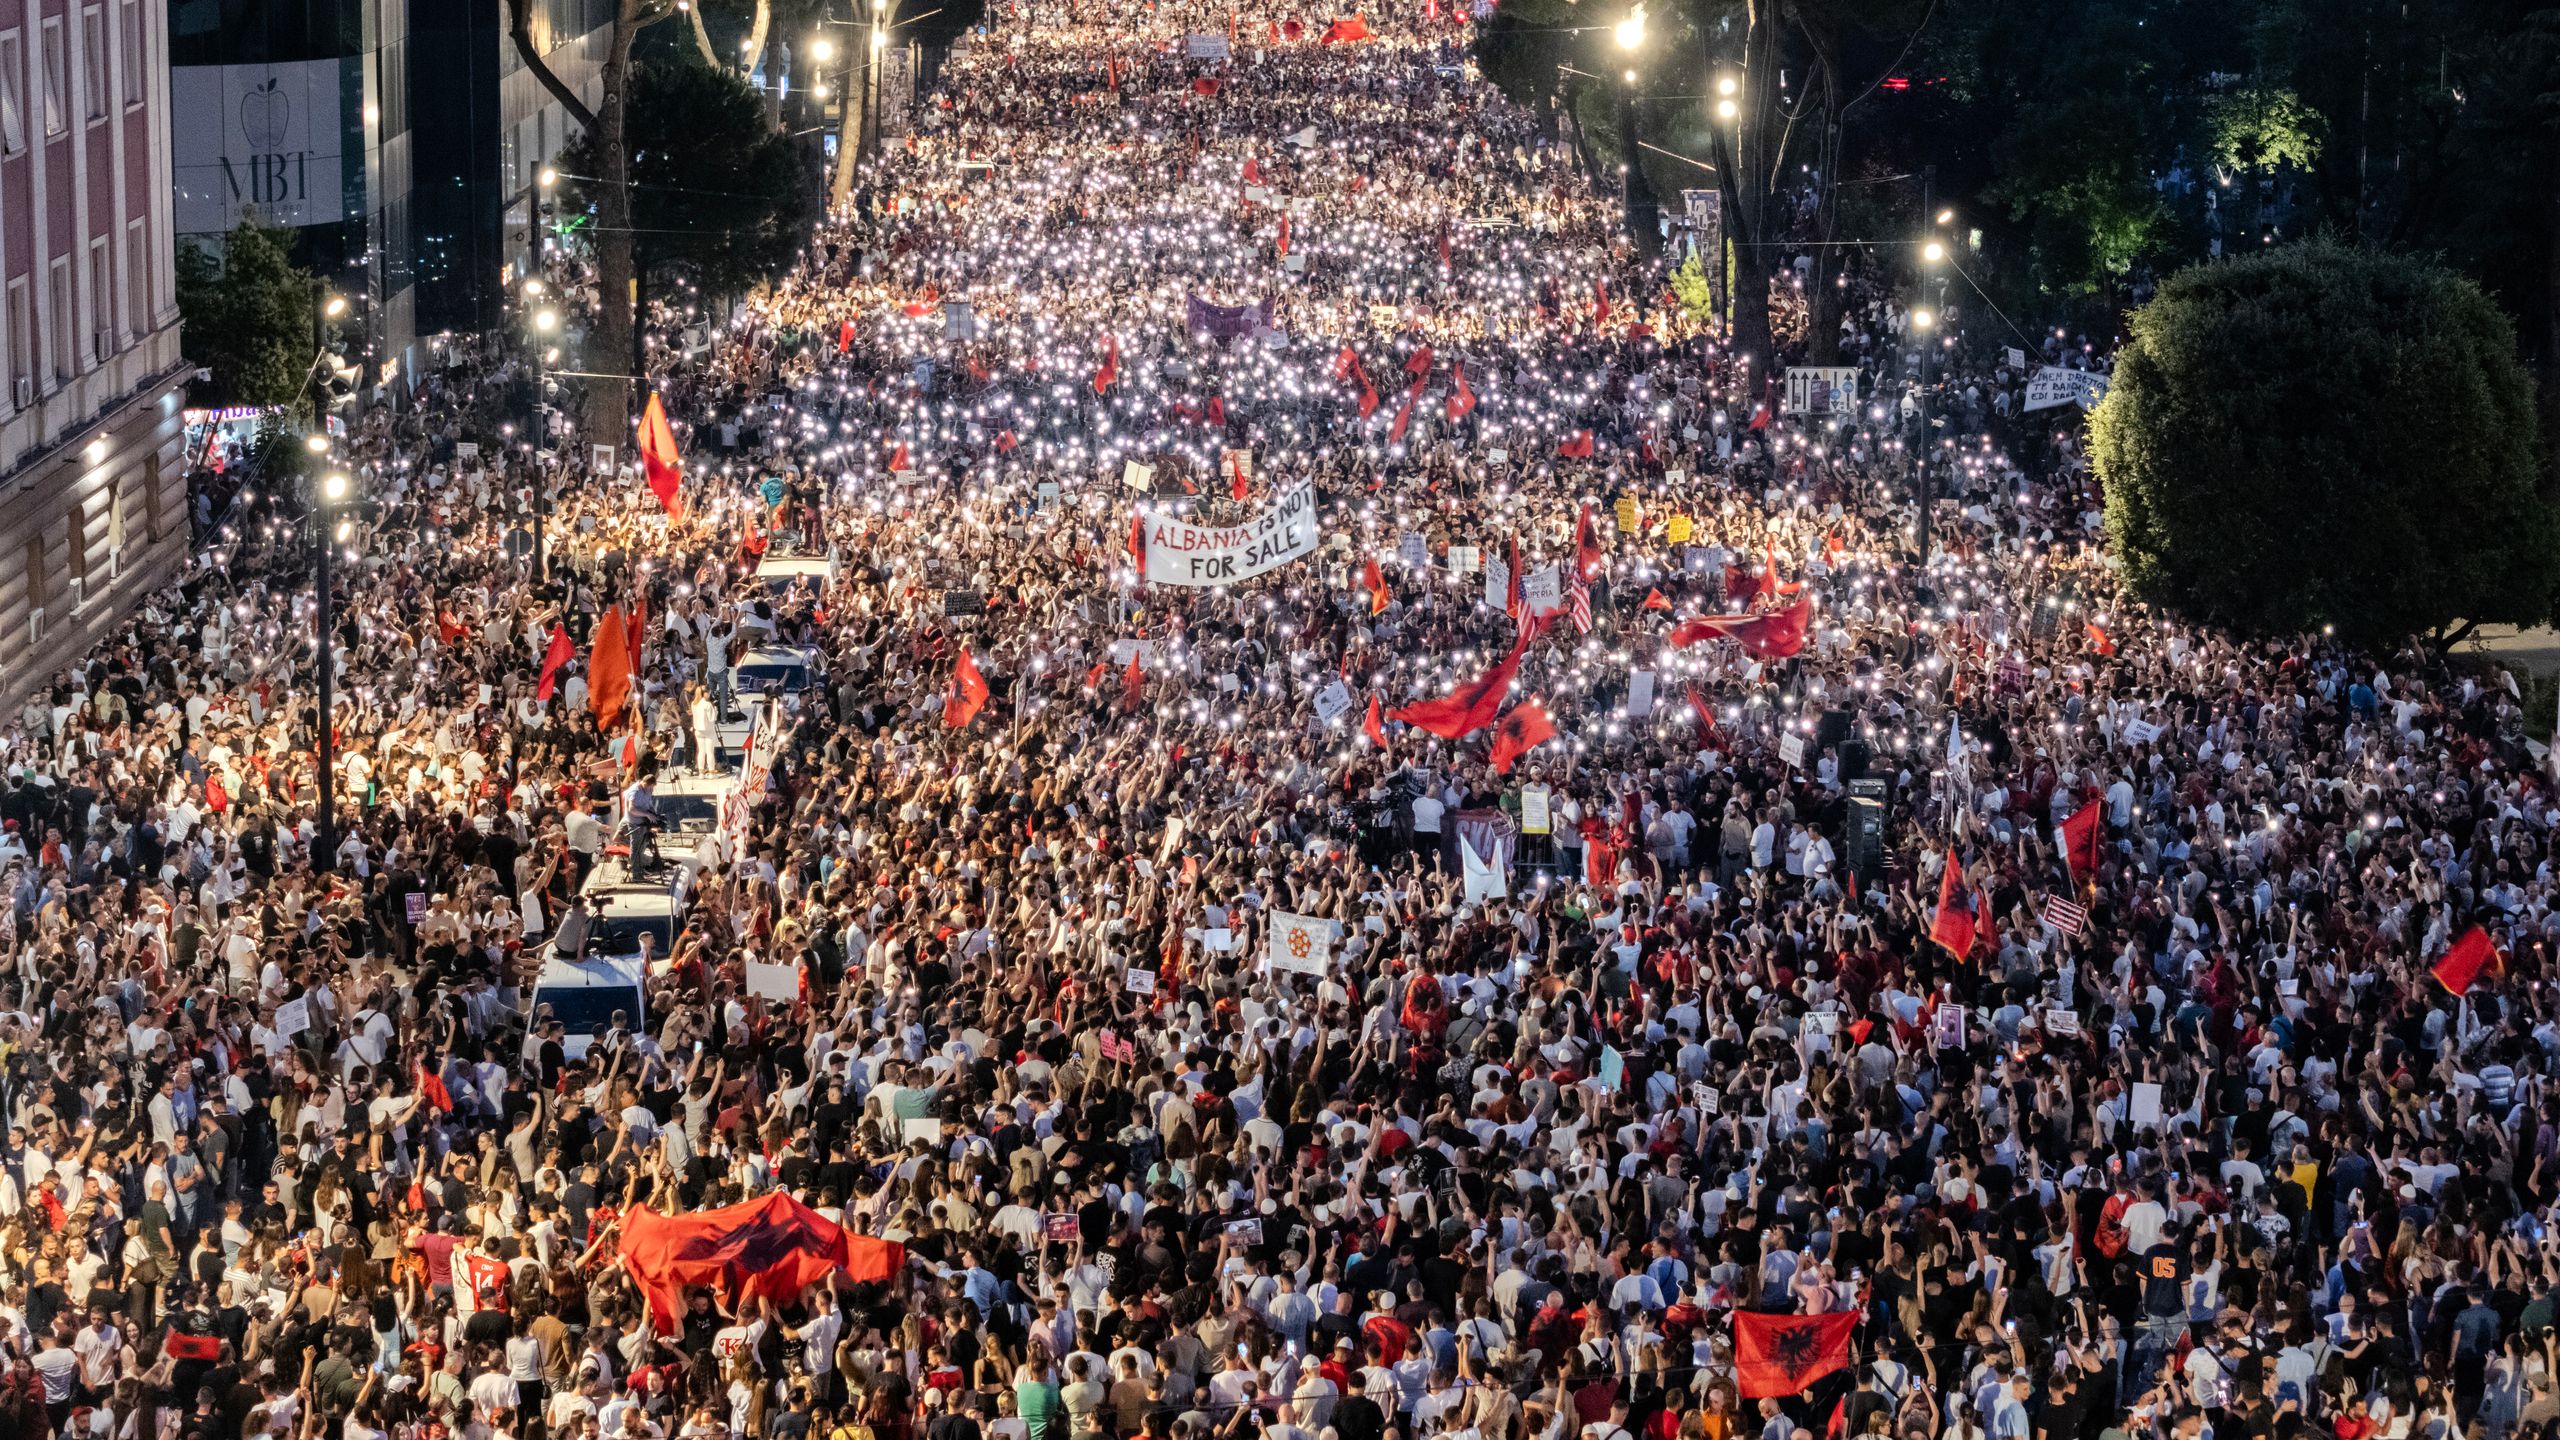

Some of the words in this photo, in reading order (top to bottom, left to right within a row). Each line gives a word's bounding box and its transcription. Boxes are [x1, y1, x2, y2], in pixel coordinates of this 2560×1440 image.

[217, 151, 314, 205] MBT
[2031, 392, 2048, 400] EDI
[1152, 524, 1252, 551] ALBANIA
[1258, 513, 1274, 535] IS
[1279, 482, 1311, 523] NOT
[1191, 555, 1236, 578] FOR
[1246, 521, 1302, 567] SALE
[475, 1271, 494, 1293] 14
[2152, 1256, 2176, 1278] 05
